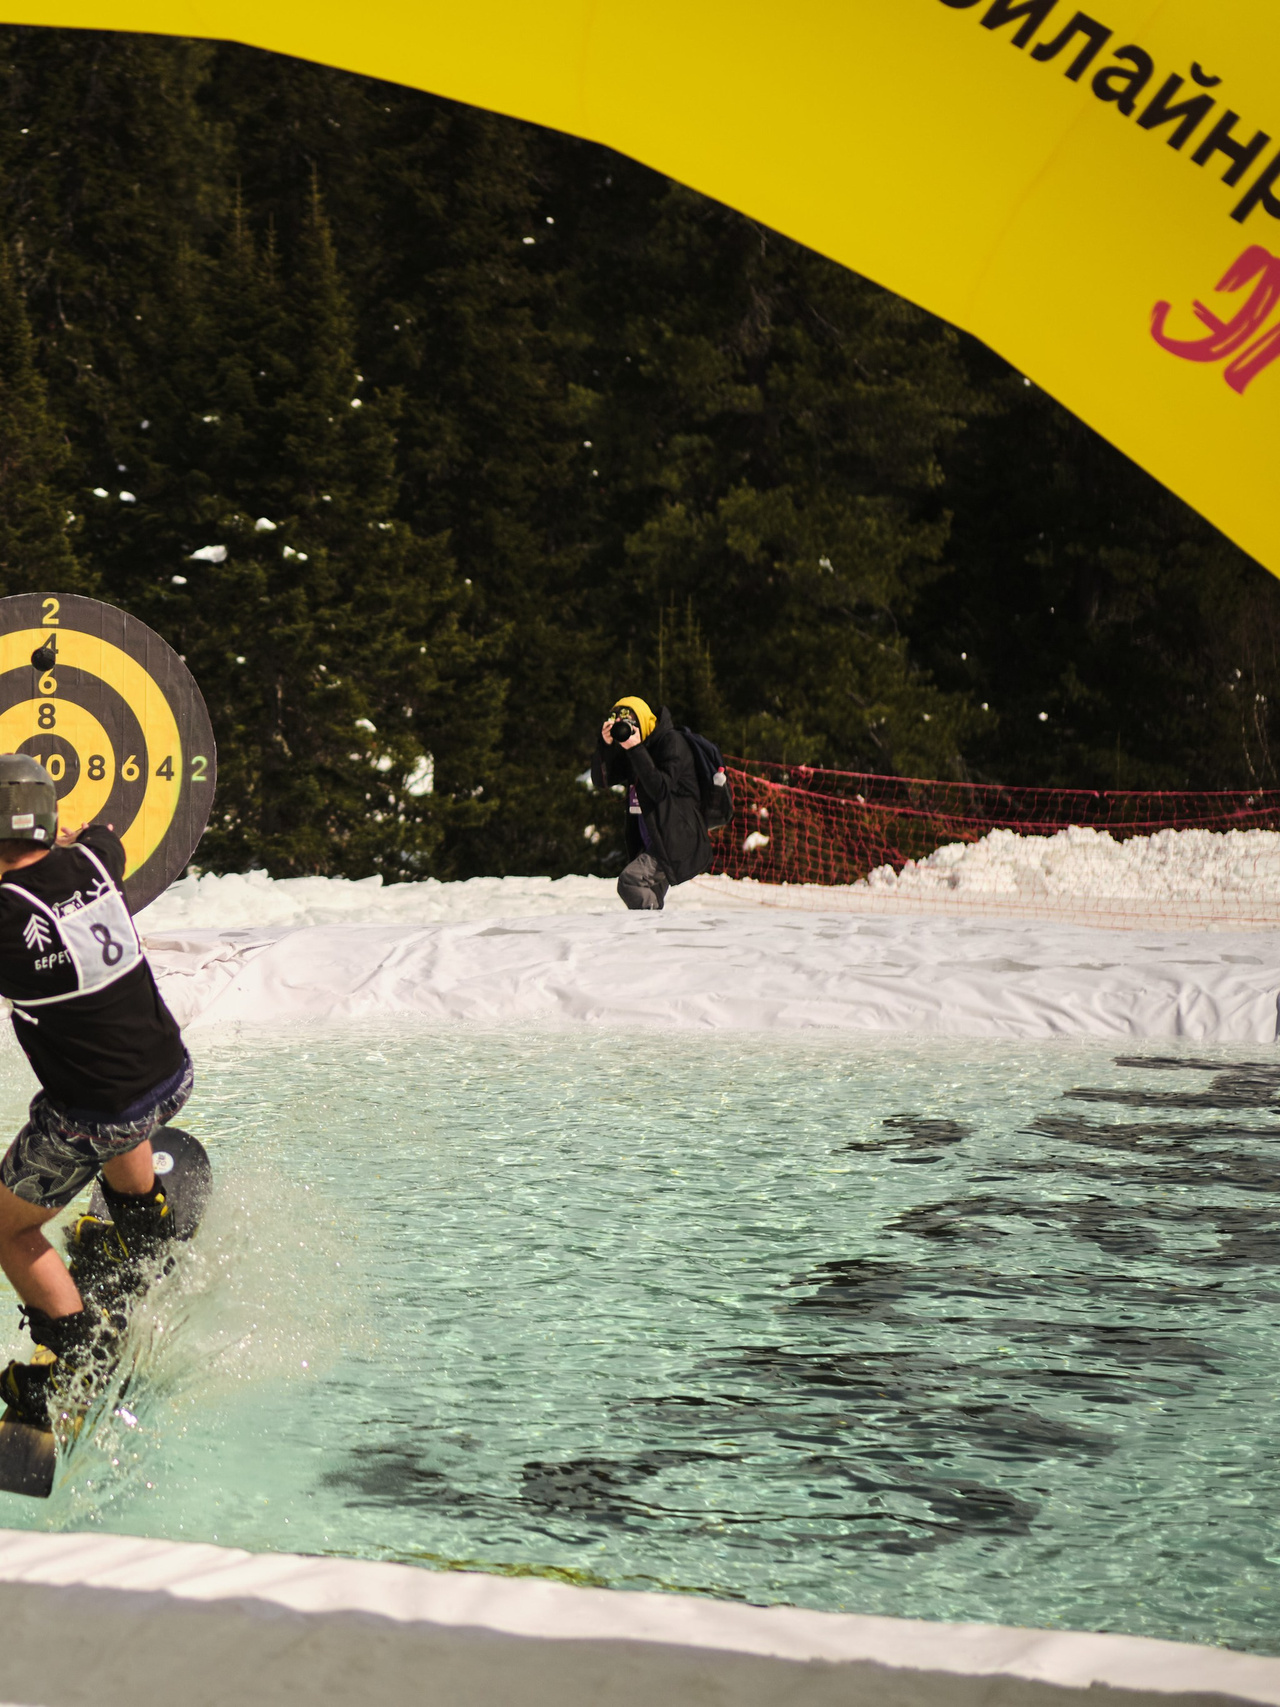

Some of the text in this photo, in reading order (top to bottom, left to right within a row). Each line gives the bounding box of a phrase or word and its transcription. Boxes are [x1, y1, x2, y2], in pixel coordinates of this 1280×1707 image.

[938, 0, 1280, 224] илайнр
[37, 597, 60, 730] 2 4 6 8
[87, 754, 106, 781] 8
[121, 755, 140, 782] 6
[155, 755, 175, 782] 4
[191, 755, 208, 782] 2
[90, 923, 124, 967] 8
